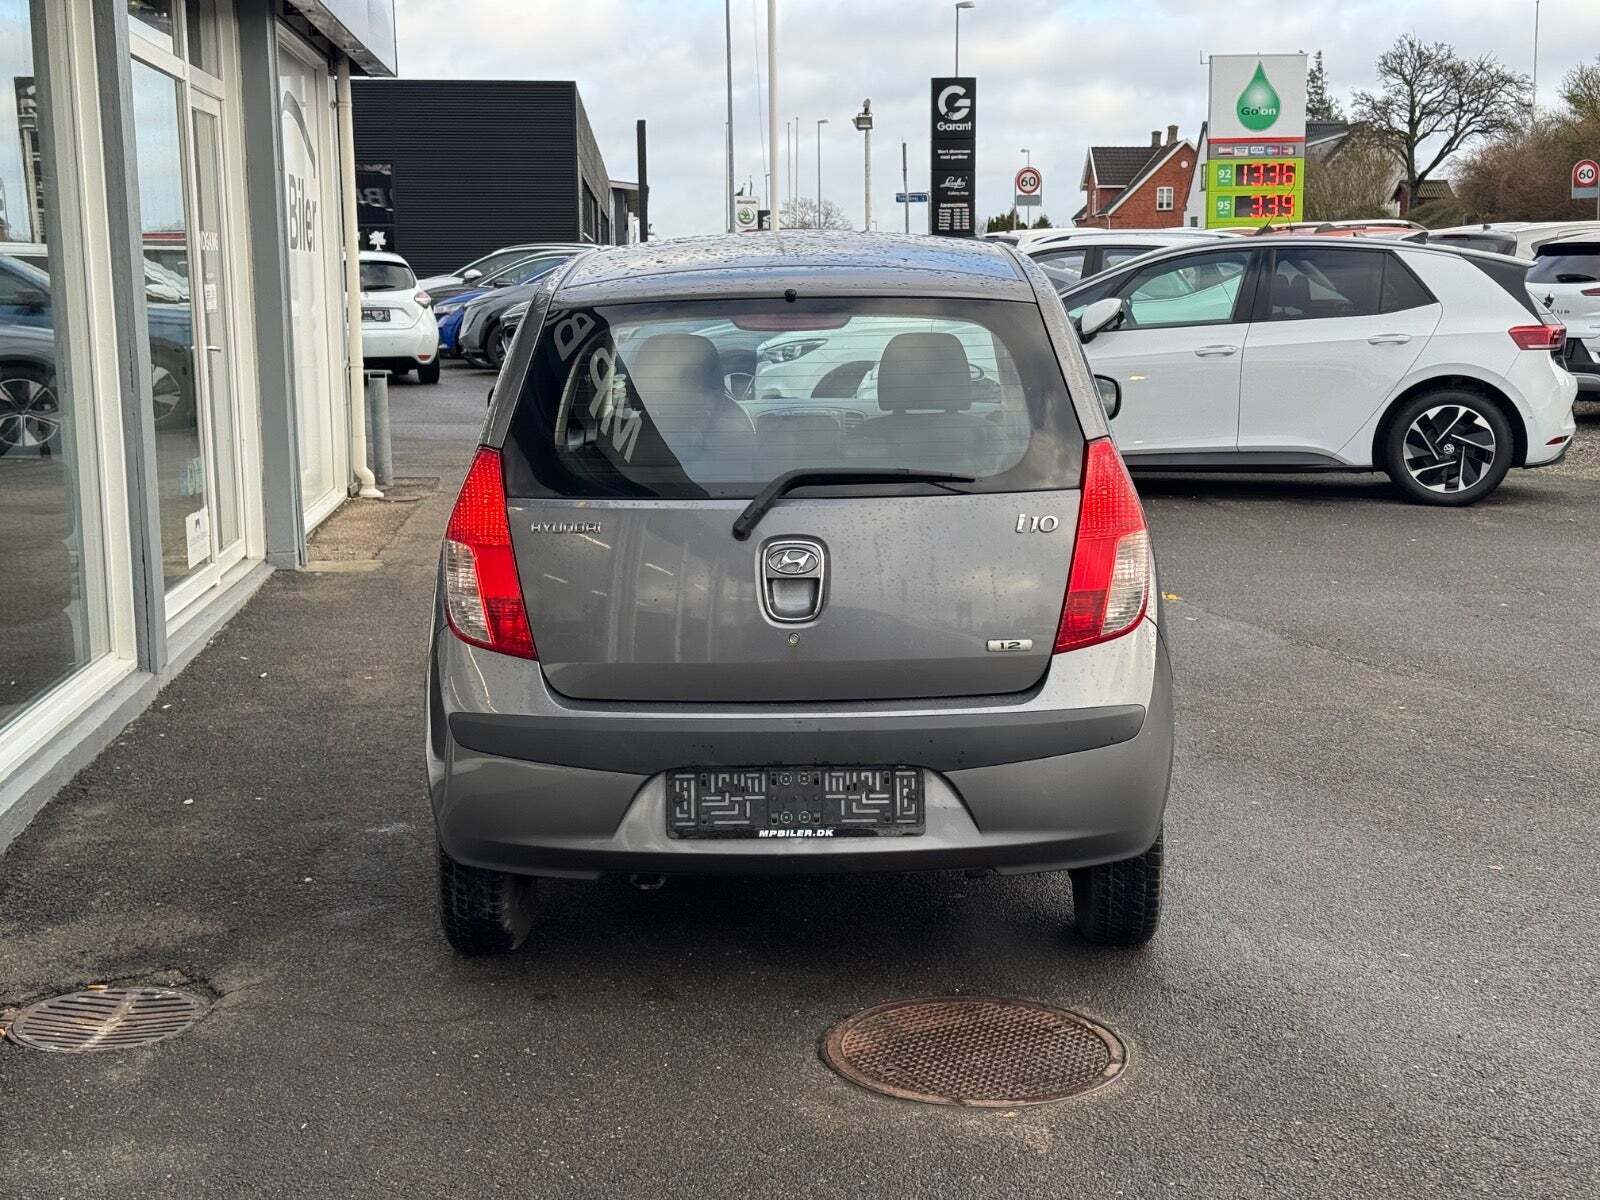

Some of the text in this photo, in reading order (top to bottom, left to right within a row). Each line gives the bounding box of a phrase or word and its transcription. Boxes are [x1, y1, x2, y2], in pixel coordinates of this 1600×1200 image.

[1241, 106, 1276, 116] Go'on
[937, 121, 972, 131] Garant
[1218, 169, 1231, 179] 92
[1578, 169, 1594, 179] 60
[1021, 176, 1036, 187] 60
[1217, 201, 1230, 210] 95
[289, 174, 316, 252] Biler
[531, 522, 601, 534] HYUNDAI
[1016, 513, 1059, 533] i10
[759, 829, 834, 837] MPBILER.DK
